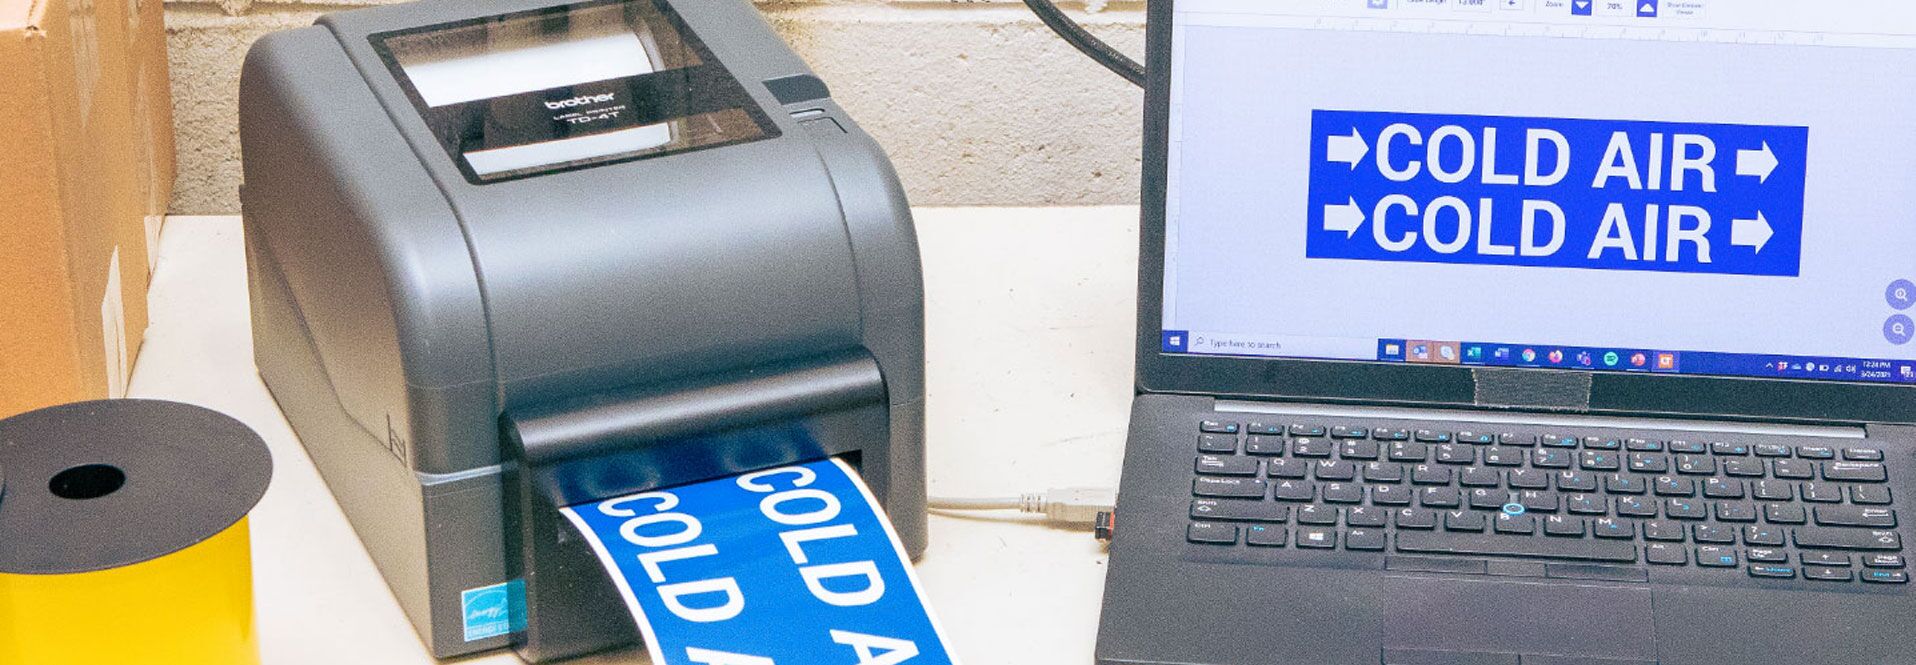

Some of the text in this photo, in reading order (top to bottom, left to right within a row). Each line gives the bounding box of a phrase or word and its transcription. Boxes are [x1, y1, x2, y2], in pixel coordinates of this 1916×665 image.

[544, 93, 614, 110] brother
[567, 111, 619, 124] TD-4T
[586, 105, 626, 115] PRINTER
[1376, 123, 1718, 192] COLD AIR
[1372, 194, 1712, 263] COLD AIR
[1210, 338, 1228, 348] Type
[1228, 340, 1245, 348] here
[1257, 341, 1281, 350] search
[598, 491, 745, 622] COLD
[736, 466, 885, 606] COLD
